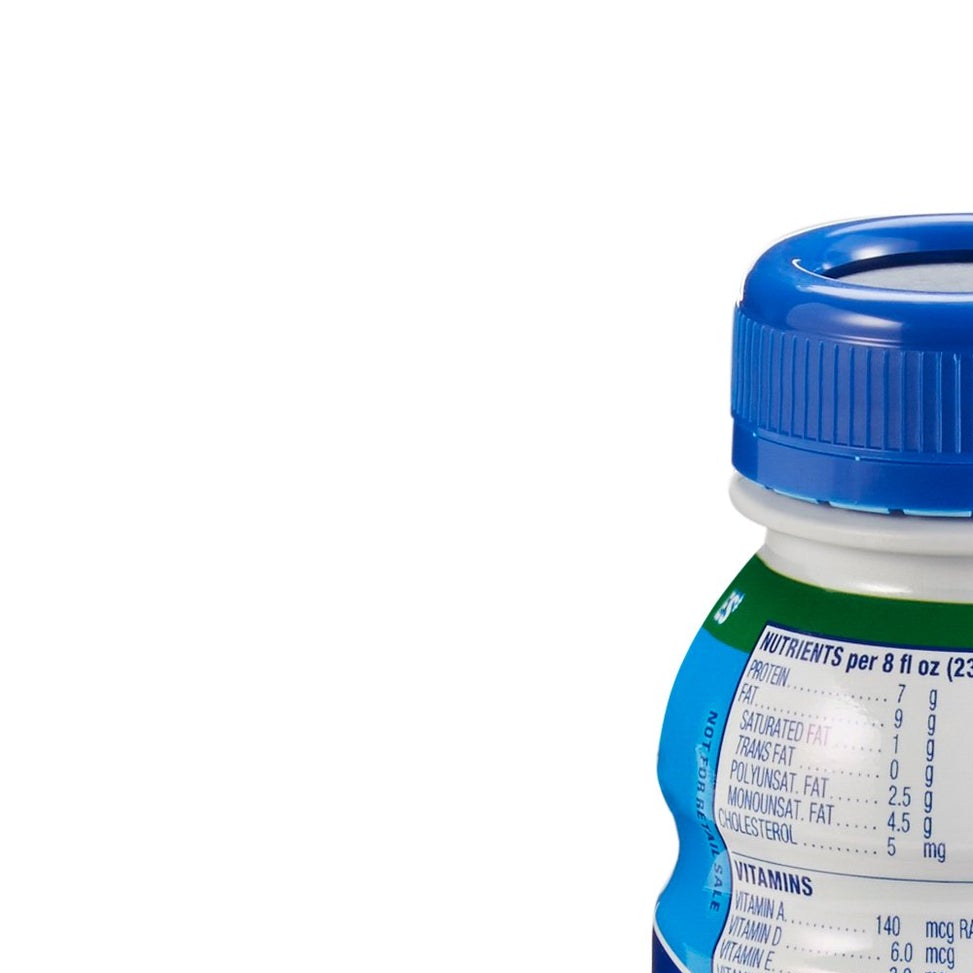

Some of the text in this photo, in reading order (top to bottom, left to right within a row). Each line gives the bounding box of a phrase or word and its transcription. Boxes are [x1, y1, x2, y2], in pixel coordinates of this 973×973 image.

[760, 631, 843, 666] NUTRIENTS
[846, 653, 876, 673] per
[883, 653, 893, 673] 8
[900, 655, 911, 674] fl
[918, 660, 940, 676] oz
[739, 685, 935, 735] FAT 9 g
[748, 659, 937, 711] PROTEIN 7 g
[735, 735, 934, 786] TRANS FAT 0 g
[739, 710, 934, 761] SATURATED FAT 1 g
[695, 710, 723, 912] NOT FOR RETAIL SALE
[728, 786, 932, 838] MONOUNSAT. FAT 4.5 g
[730, 760, 932, 813] POLYUNSAT. FAT 2.5 g
[718, 808, 946, 863] CHOLESTEROL 5 mg
[734, 860, 813, 896] VITAMINS
[728, 915, 955, 969] VITAMIN D 6.0 mcg
[734, 890, 775, 919] VITAMIN
[776, 901, 785, 920] A
[876, 915, 901, 936] 140
[925, 920, 954, 943] mcg
[719, 939, 762, 967] VITAMIN
[764, 950, 775, 971] E
